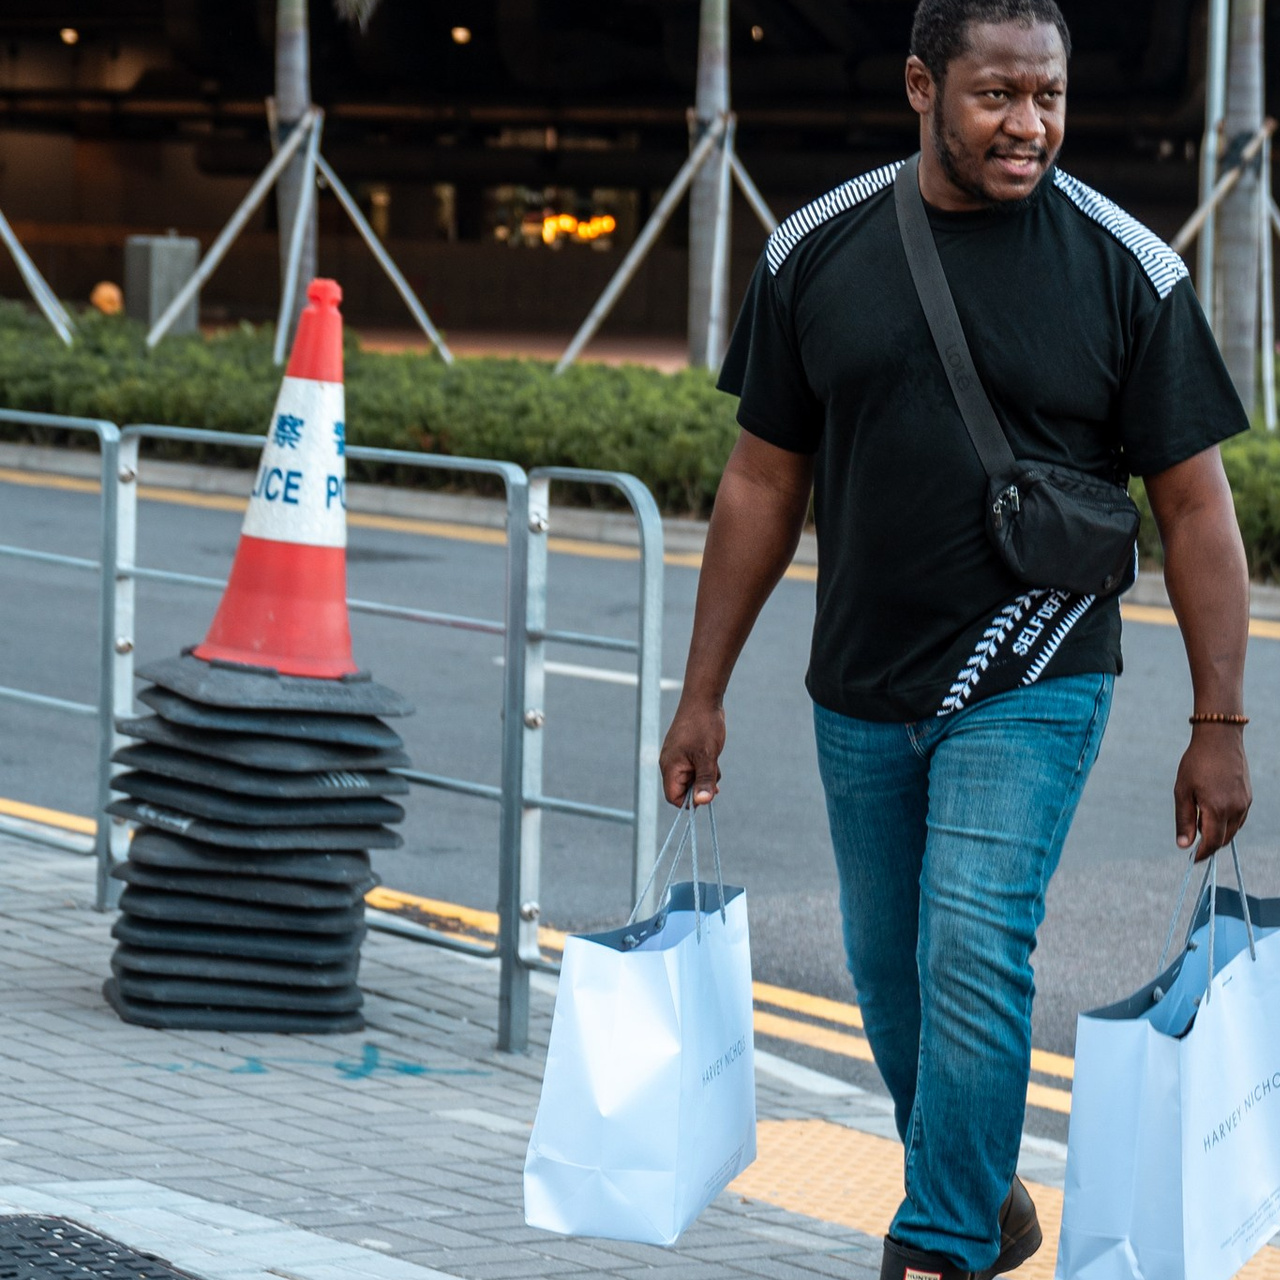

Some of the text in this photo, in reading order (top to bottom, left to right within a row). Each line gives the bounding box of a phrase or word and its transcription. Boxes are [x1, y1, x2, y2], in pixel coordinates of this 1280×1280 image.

[252, 467, 302, 506] ICE
[1012, 615, 1045, 656] SELF
[1203, 1105, 1242, 1154] HARVEY
